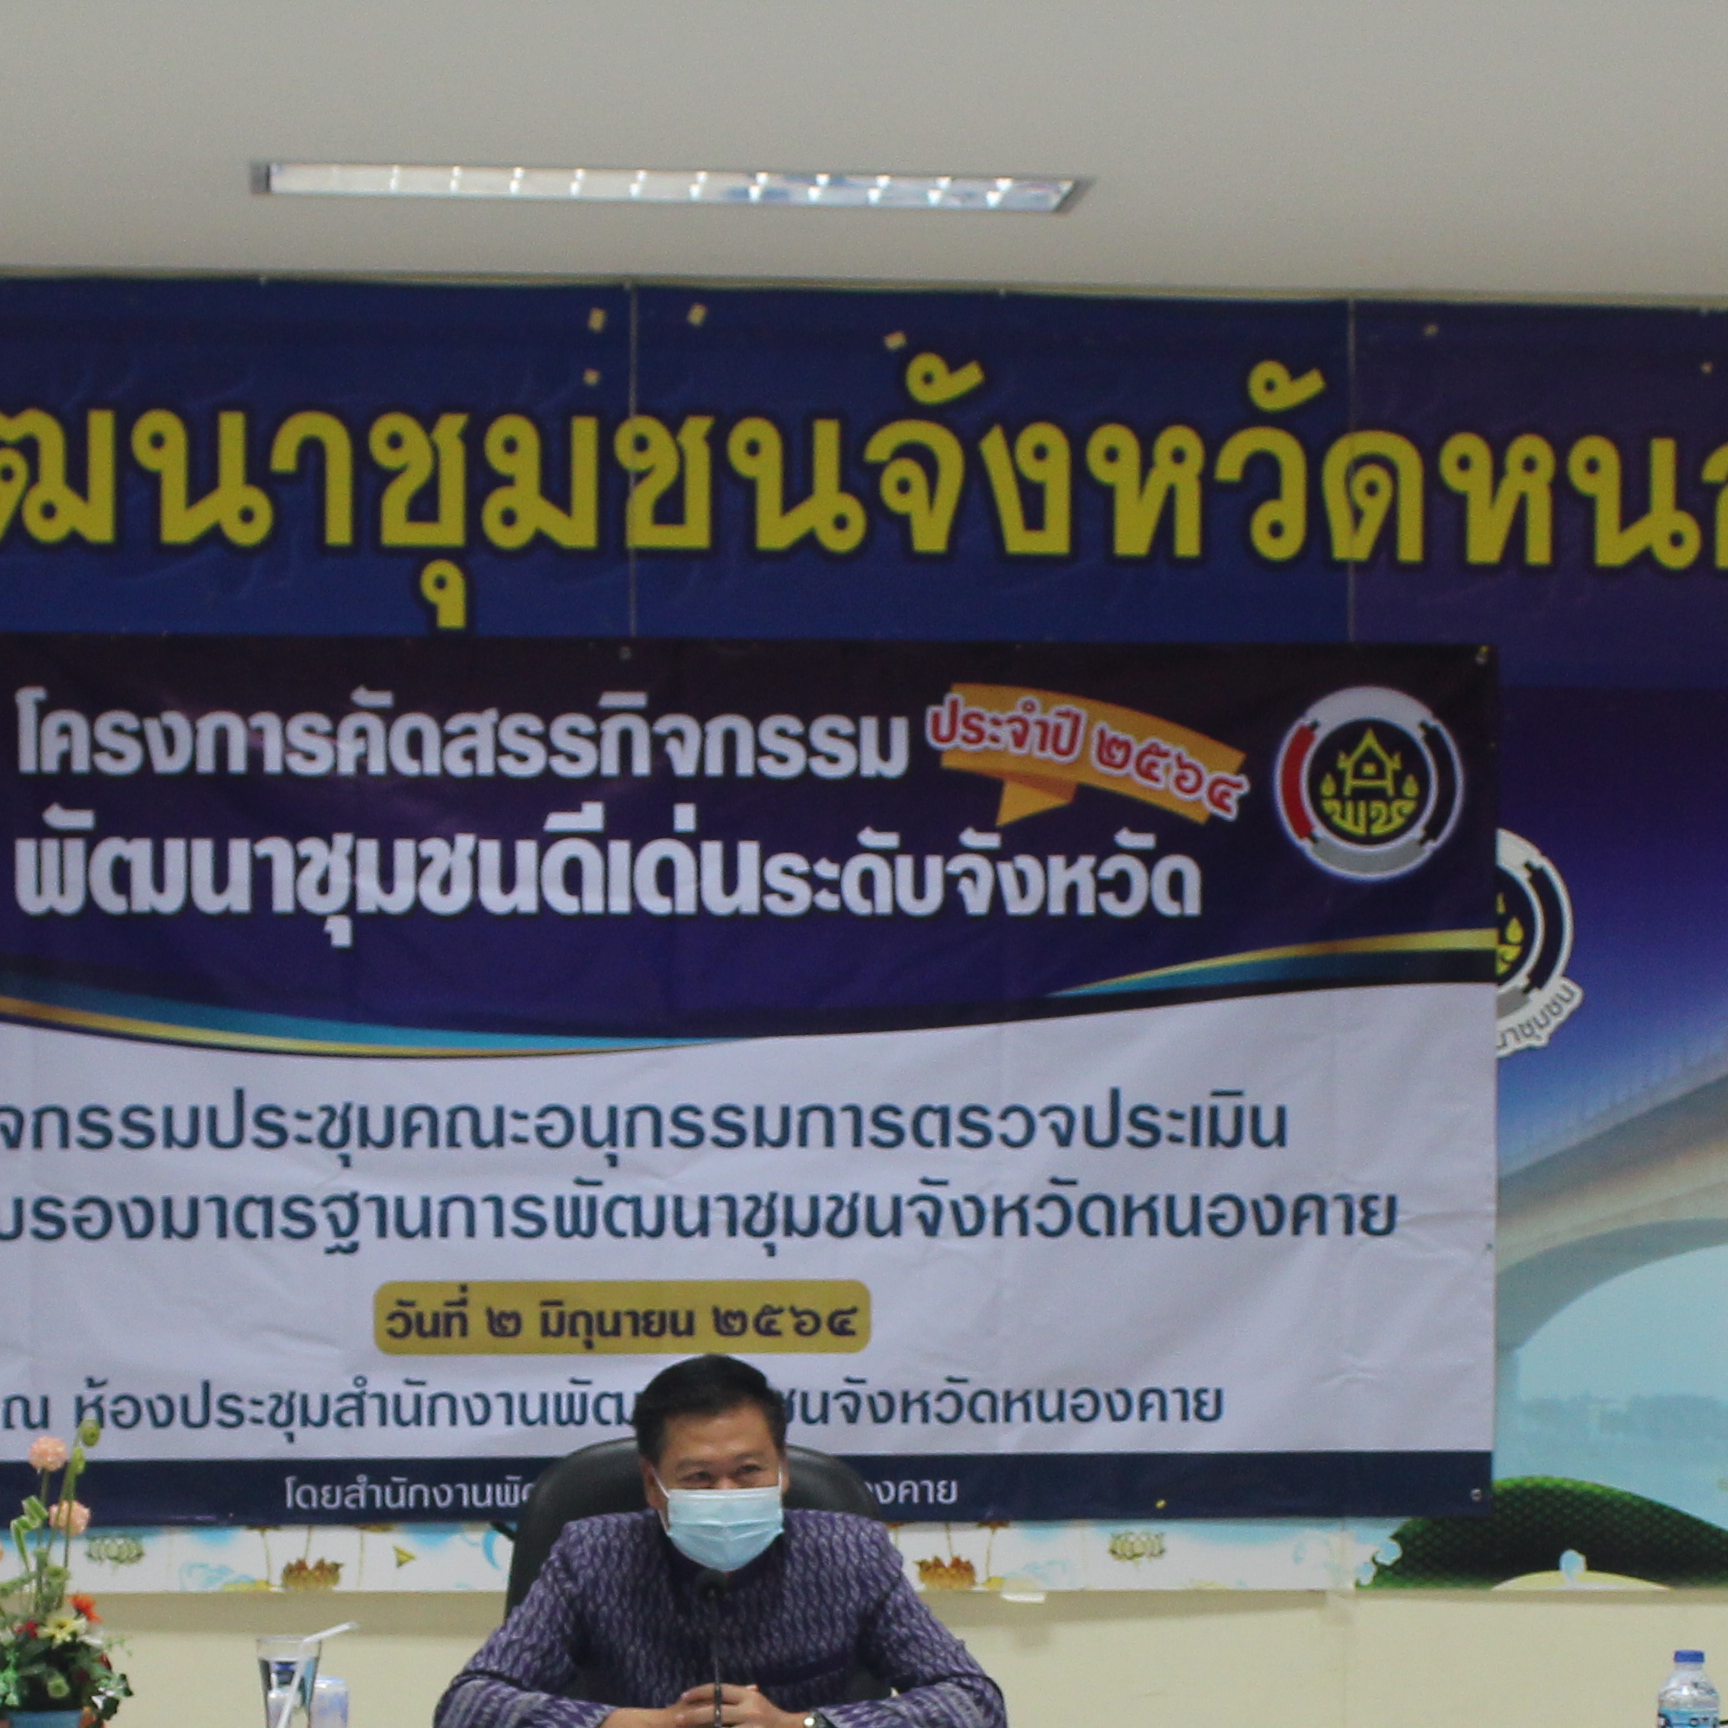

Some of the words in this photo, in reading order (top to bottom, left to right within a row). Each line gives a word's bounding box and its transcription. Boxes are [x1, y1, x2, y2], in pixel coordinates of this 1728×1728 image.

[15, 686, 911, 780] โครงการคัดสรรกิจกรรม
[926, 693, 1087, 764] ประจำปี
[1092, 722, 1250, 819] ๒๕๖๔
[15, 800, 1202, 948] พัฒนาชุมชนดีเด่นระดับจังหวัด
[385, 1284, 469, 1339] วันที่
[485, 1305, 522, 1338] ๒
[539, 1299, 695, 1350] มิถุนายน
[712, 1303, 859, 1338] ๒๕๖๔
[2, 1393, 50, 1431] ณ
